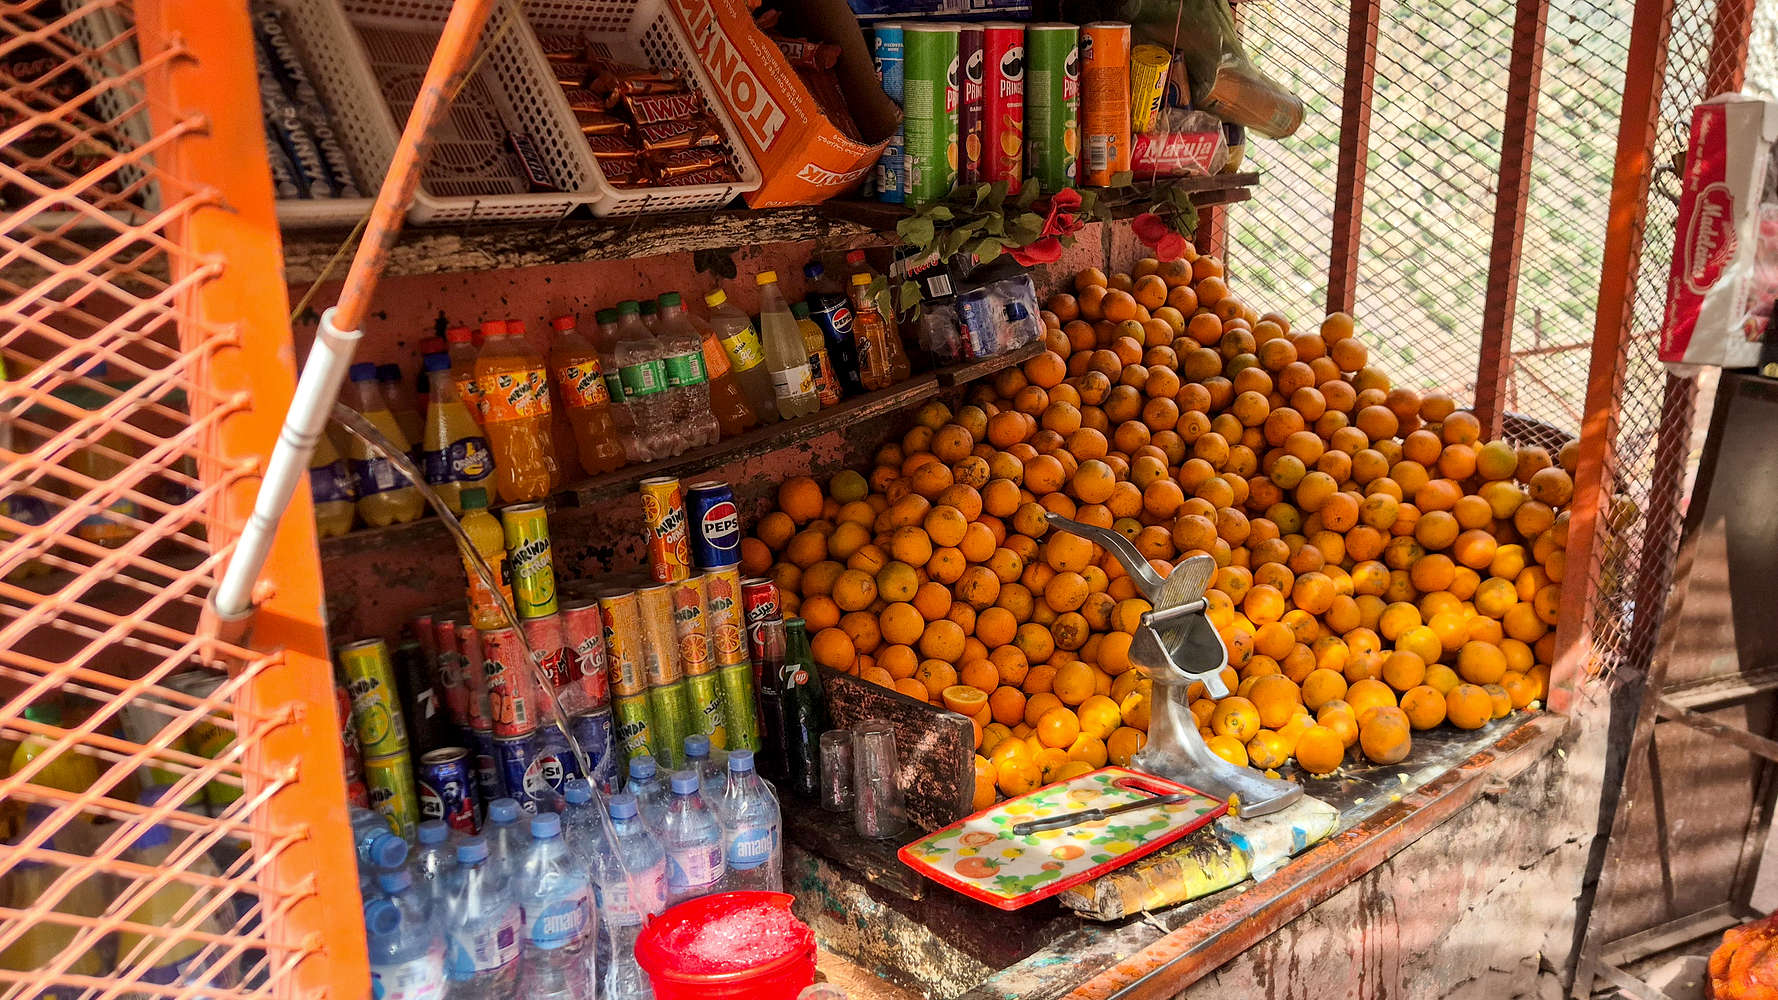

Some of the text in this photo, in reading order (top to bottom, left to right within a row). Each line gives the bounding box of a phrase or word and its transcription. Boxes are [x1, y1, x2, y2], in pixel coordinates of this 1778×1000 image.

[635, 95, 698, 123] TWIX
[1142, 136, 1213, 159] Maruja
[704, 518, 738, 533] PEPS
[511, 538, 550, 570] MIRINDA
